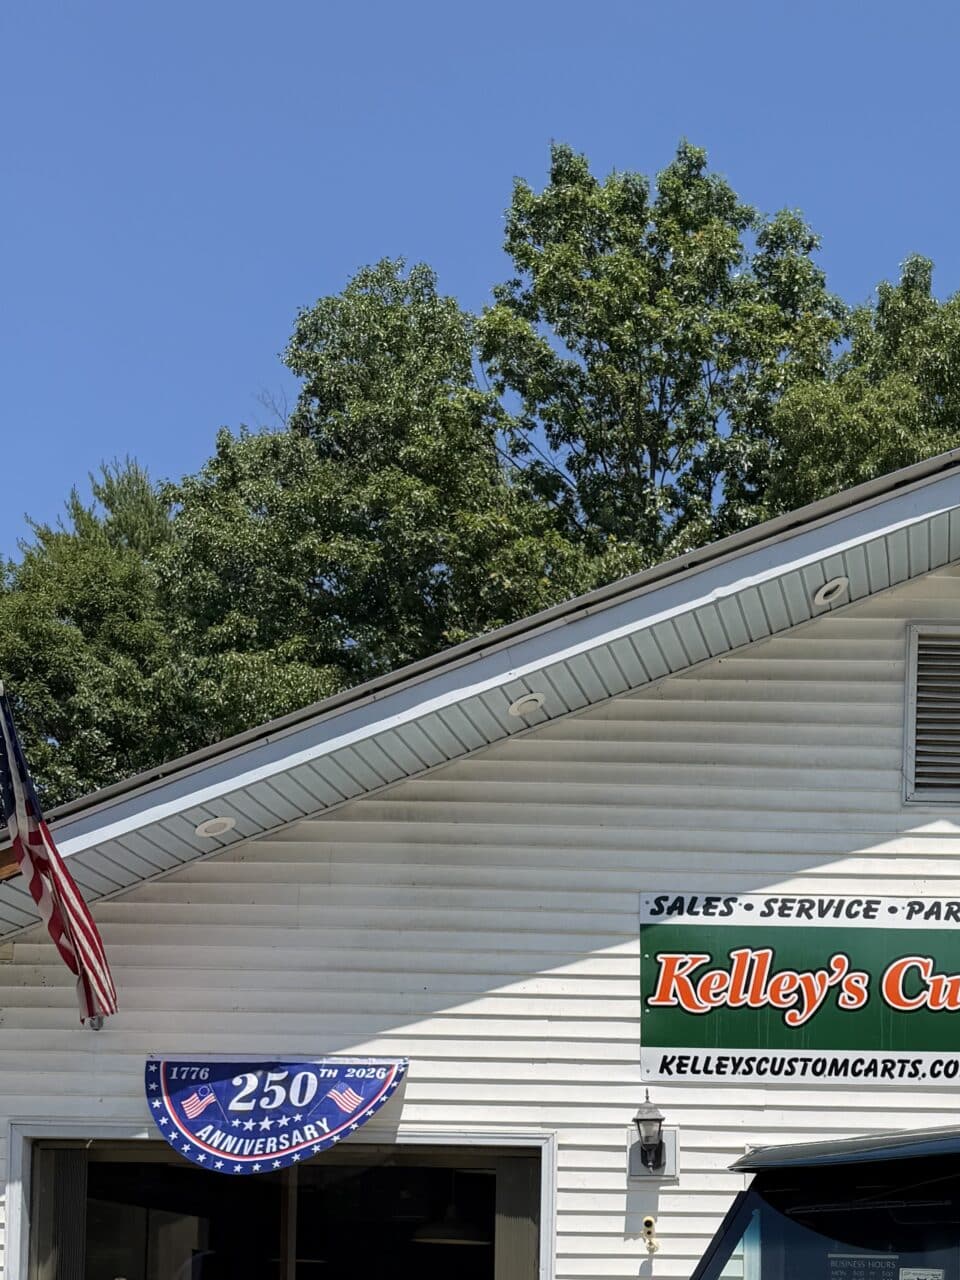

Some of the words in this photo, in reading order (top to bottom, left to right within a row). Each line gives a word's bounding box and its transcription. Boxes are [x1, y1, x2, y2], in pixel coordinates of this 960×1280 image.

[650, 896, 738, 917] SALES
[760, 898, 881, 920] SERVICE
[648, 948, 868, 1026] Kelley's
[169, 1067, 209, 1080] 1776
[345, 1067, 387, 1079] 2026
[196, 1117, 331, 1156] ANNIVERSARY
[830, 1260, 866, 1269] BUSINESS
[868, 1261, 897, 1270] HOURS
